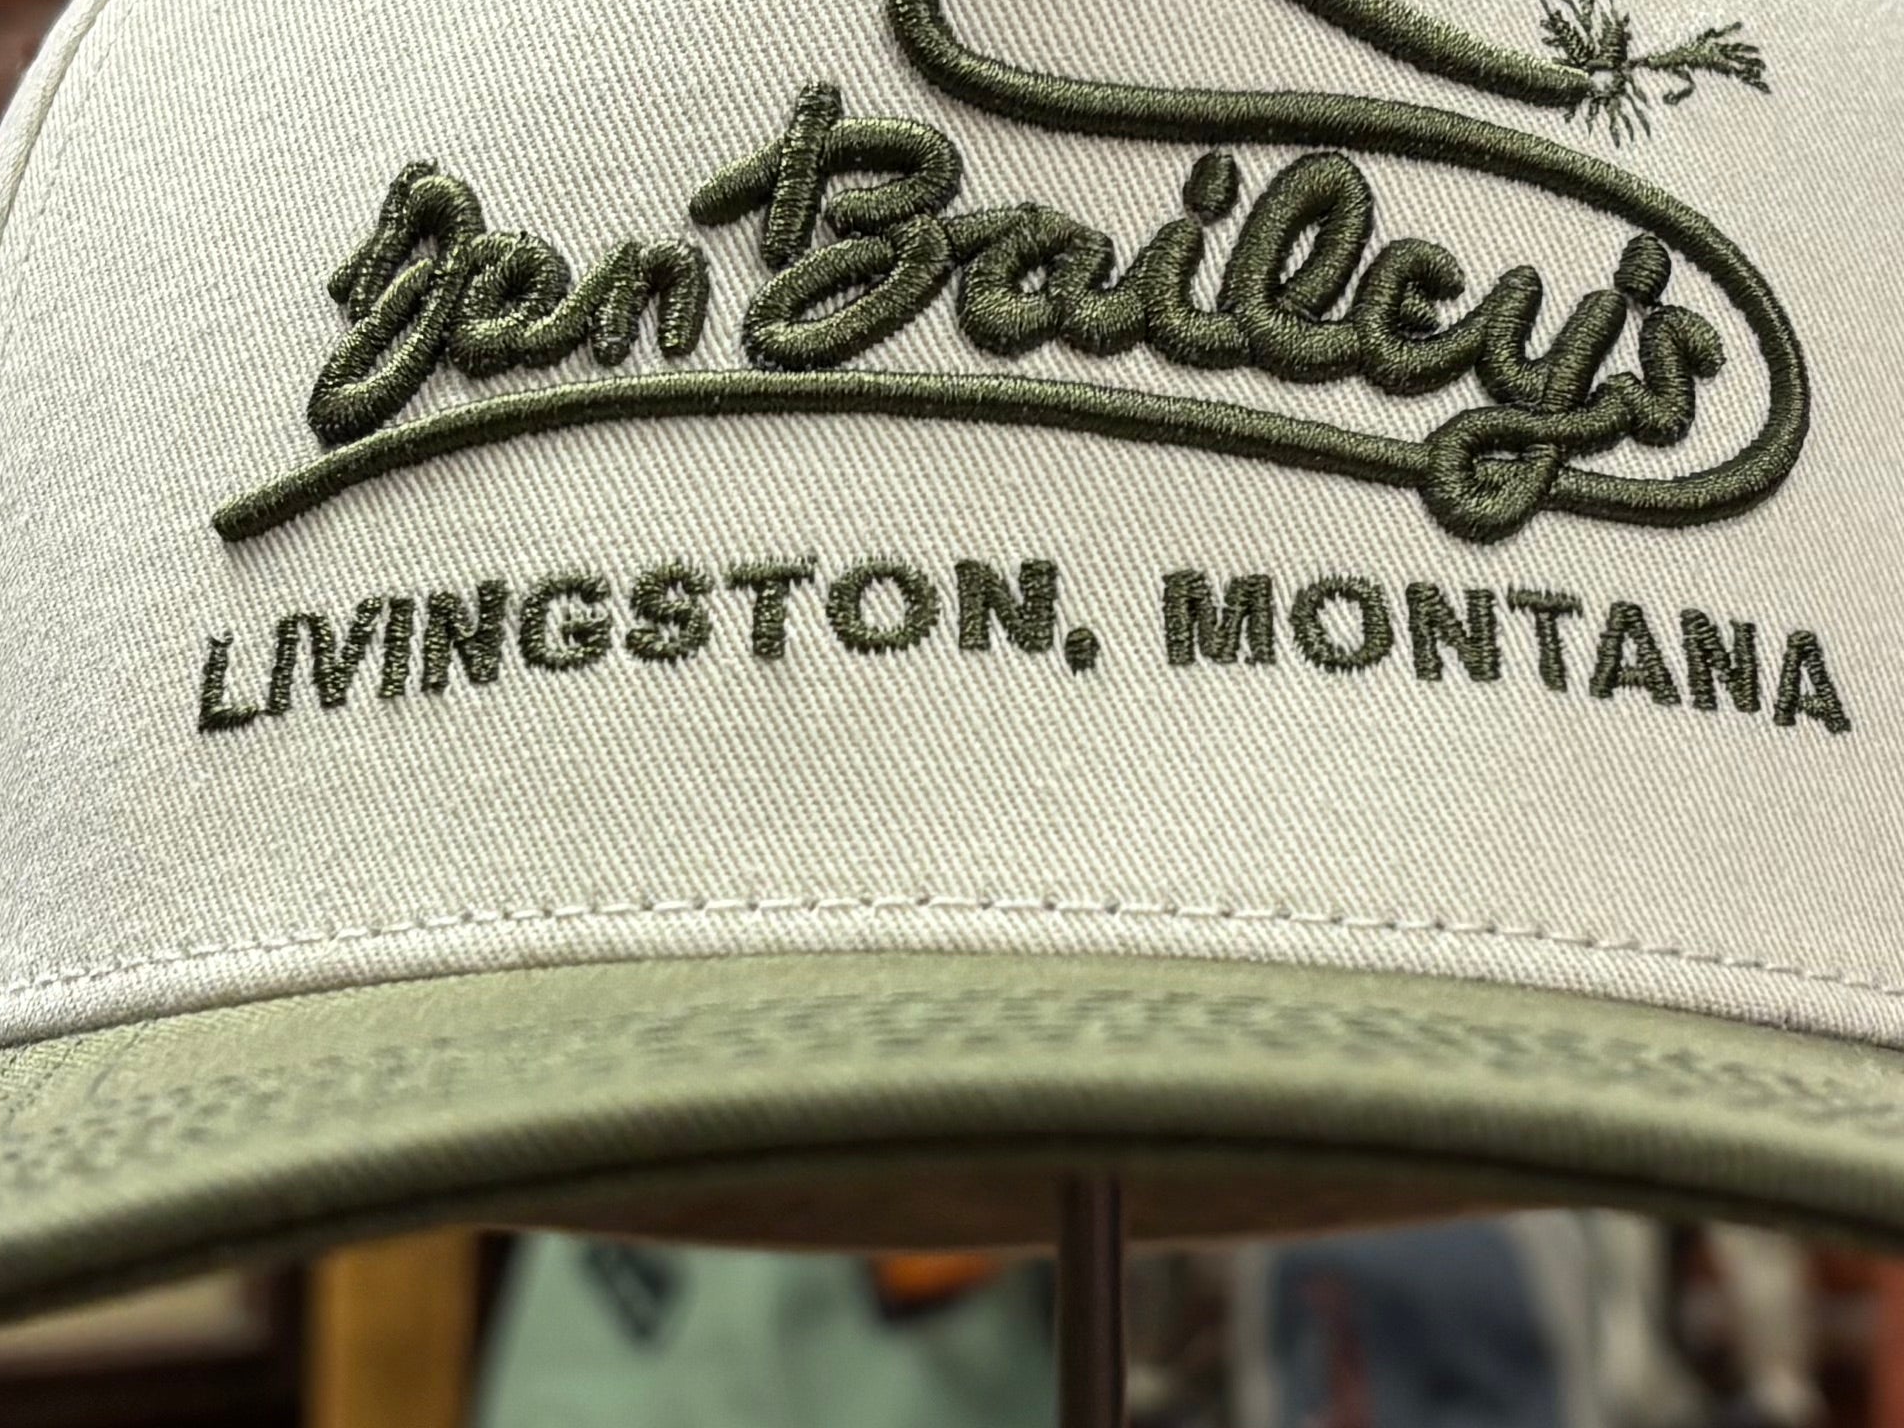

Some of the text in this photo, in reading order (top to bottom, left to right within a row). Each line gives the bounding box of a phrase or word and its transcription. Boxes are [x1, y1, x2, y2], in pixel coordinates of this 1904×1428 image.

[688, 80, 1725, 543] Bailey's
[197, 558, 1852, 736] LIVINGSTON, MONTANA
